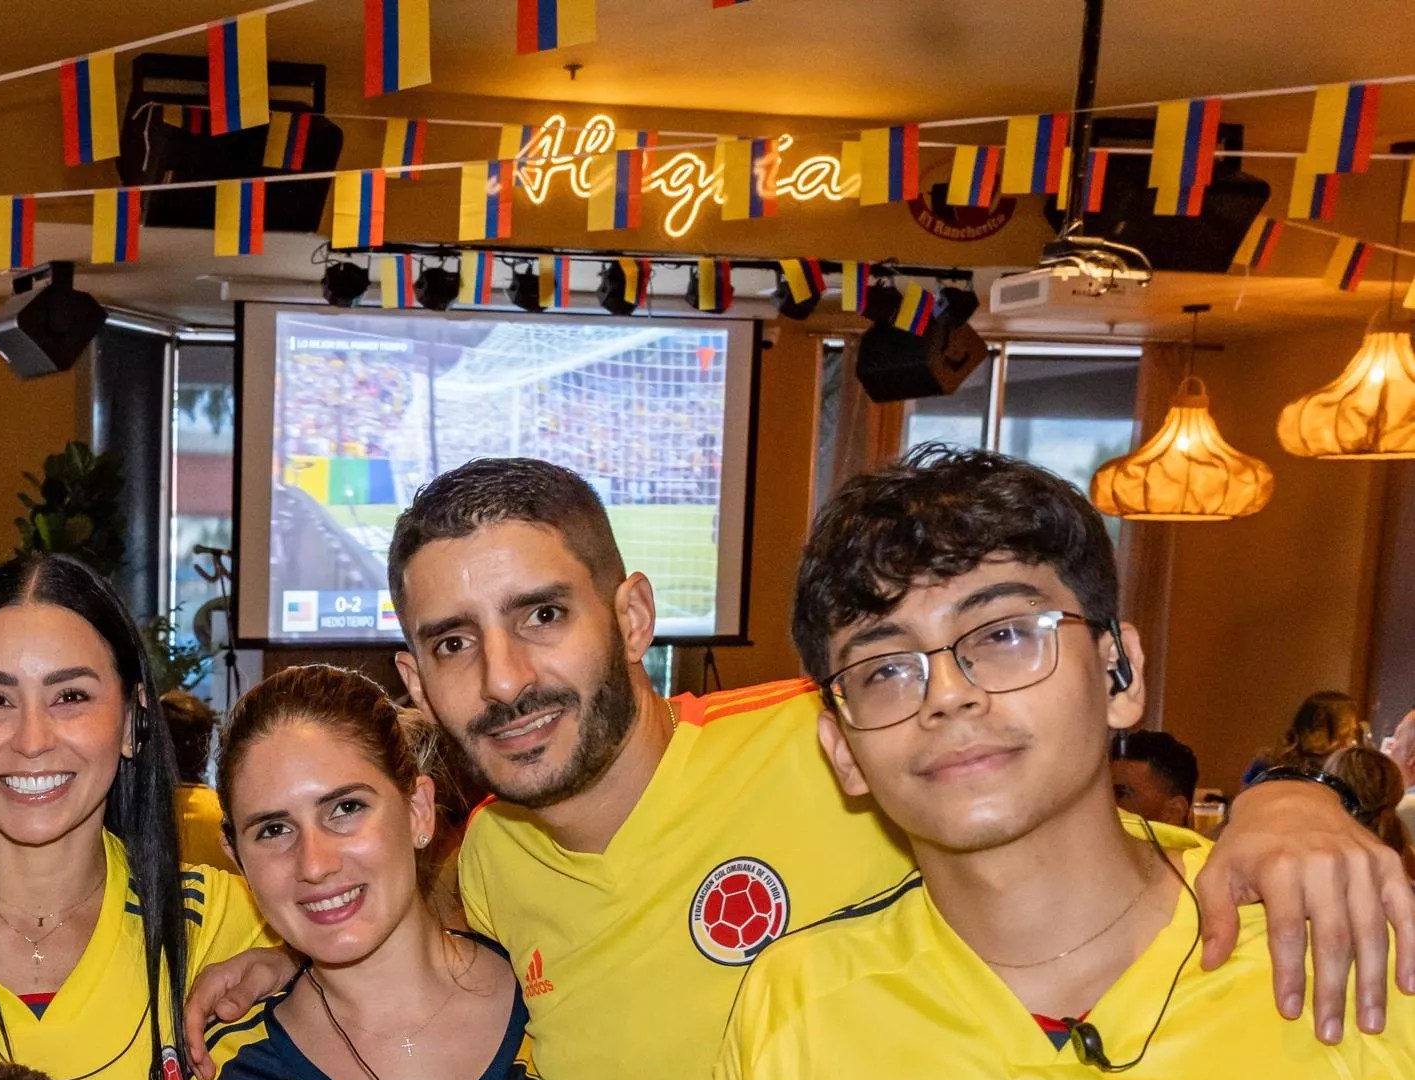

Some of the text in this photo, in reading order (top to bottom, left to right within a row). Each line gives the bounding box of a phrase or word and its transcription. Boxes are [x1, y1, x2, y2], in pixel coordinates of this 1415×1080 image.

[335, 595, 362, 613] 0-2
[320, 616, 375, 628] MEDIO TIEMPO
